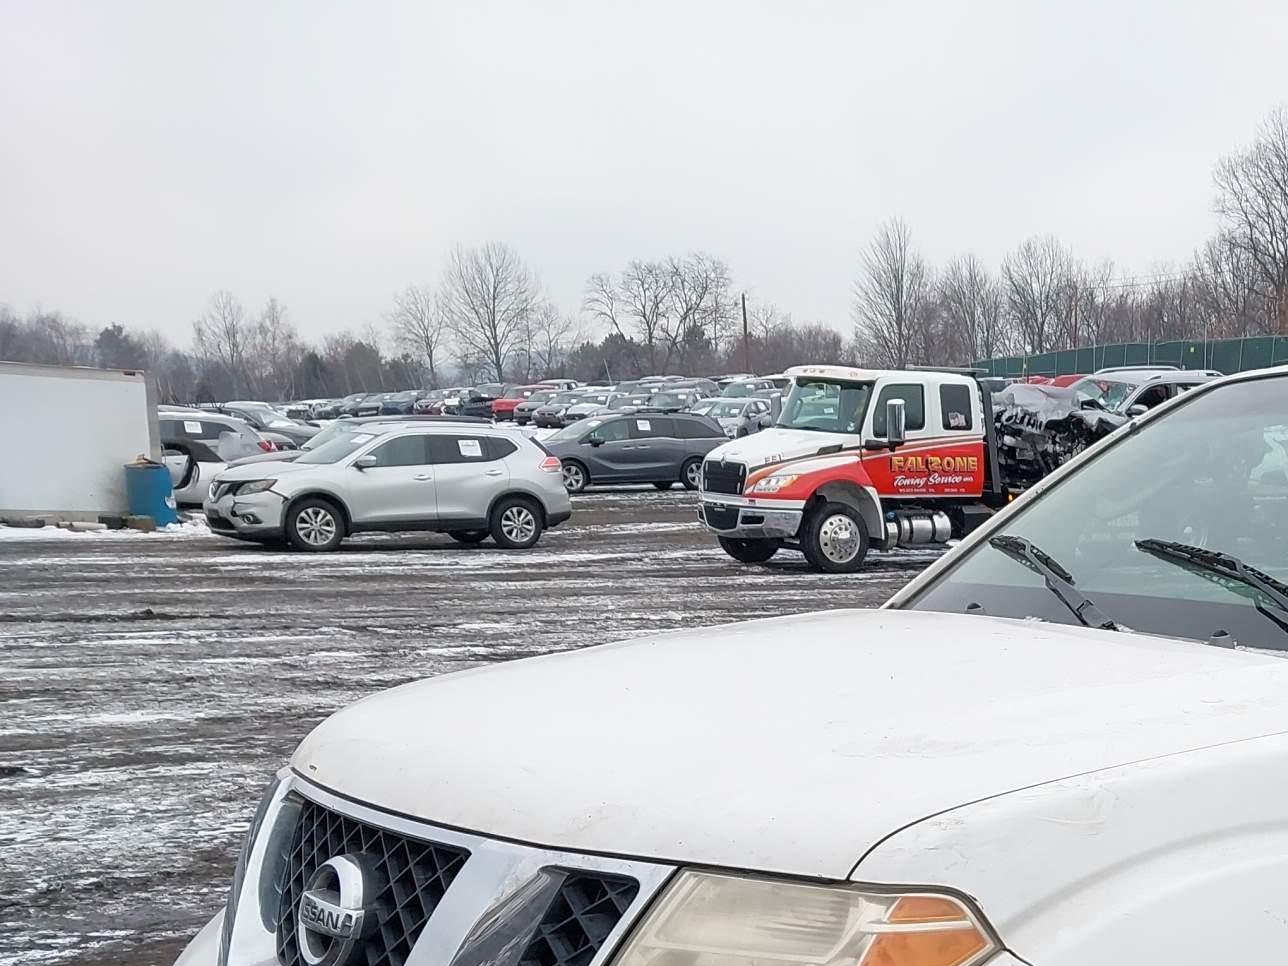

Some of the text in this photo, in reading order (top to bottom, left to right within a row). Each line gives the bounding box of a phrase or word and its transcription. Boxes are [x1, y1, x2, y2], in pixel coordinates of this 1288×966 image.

[891, 456, 978, 471] FALZONE
[894, 475, 926, 487] Towing
[928, 473, 962, 485] Service
[303, 902, 340, 930] SSAN
